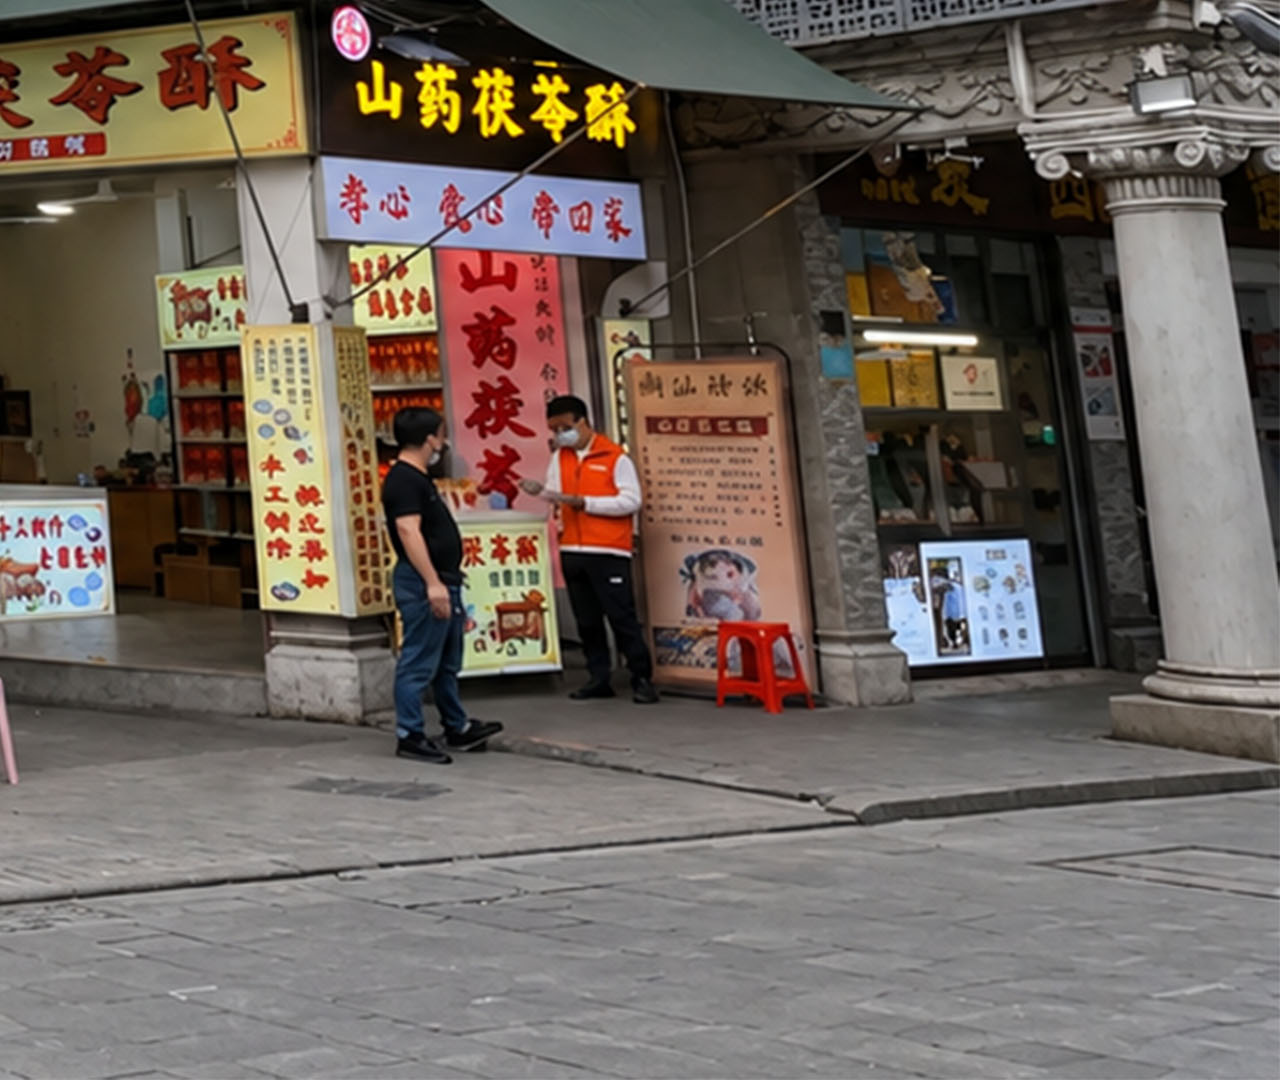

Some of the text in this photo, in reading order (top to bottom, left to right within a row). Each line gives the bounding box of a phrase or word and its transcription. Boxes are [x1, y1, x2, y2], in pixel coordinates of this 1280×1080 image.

[354, 60, 637, 149] 山药茯苓酥
